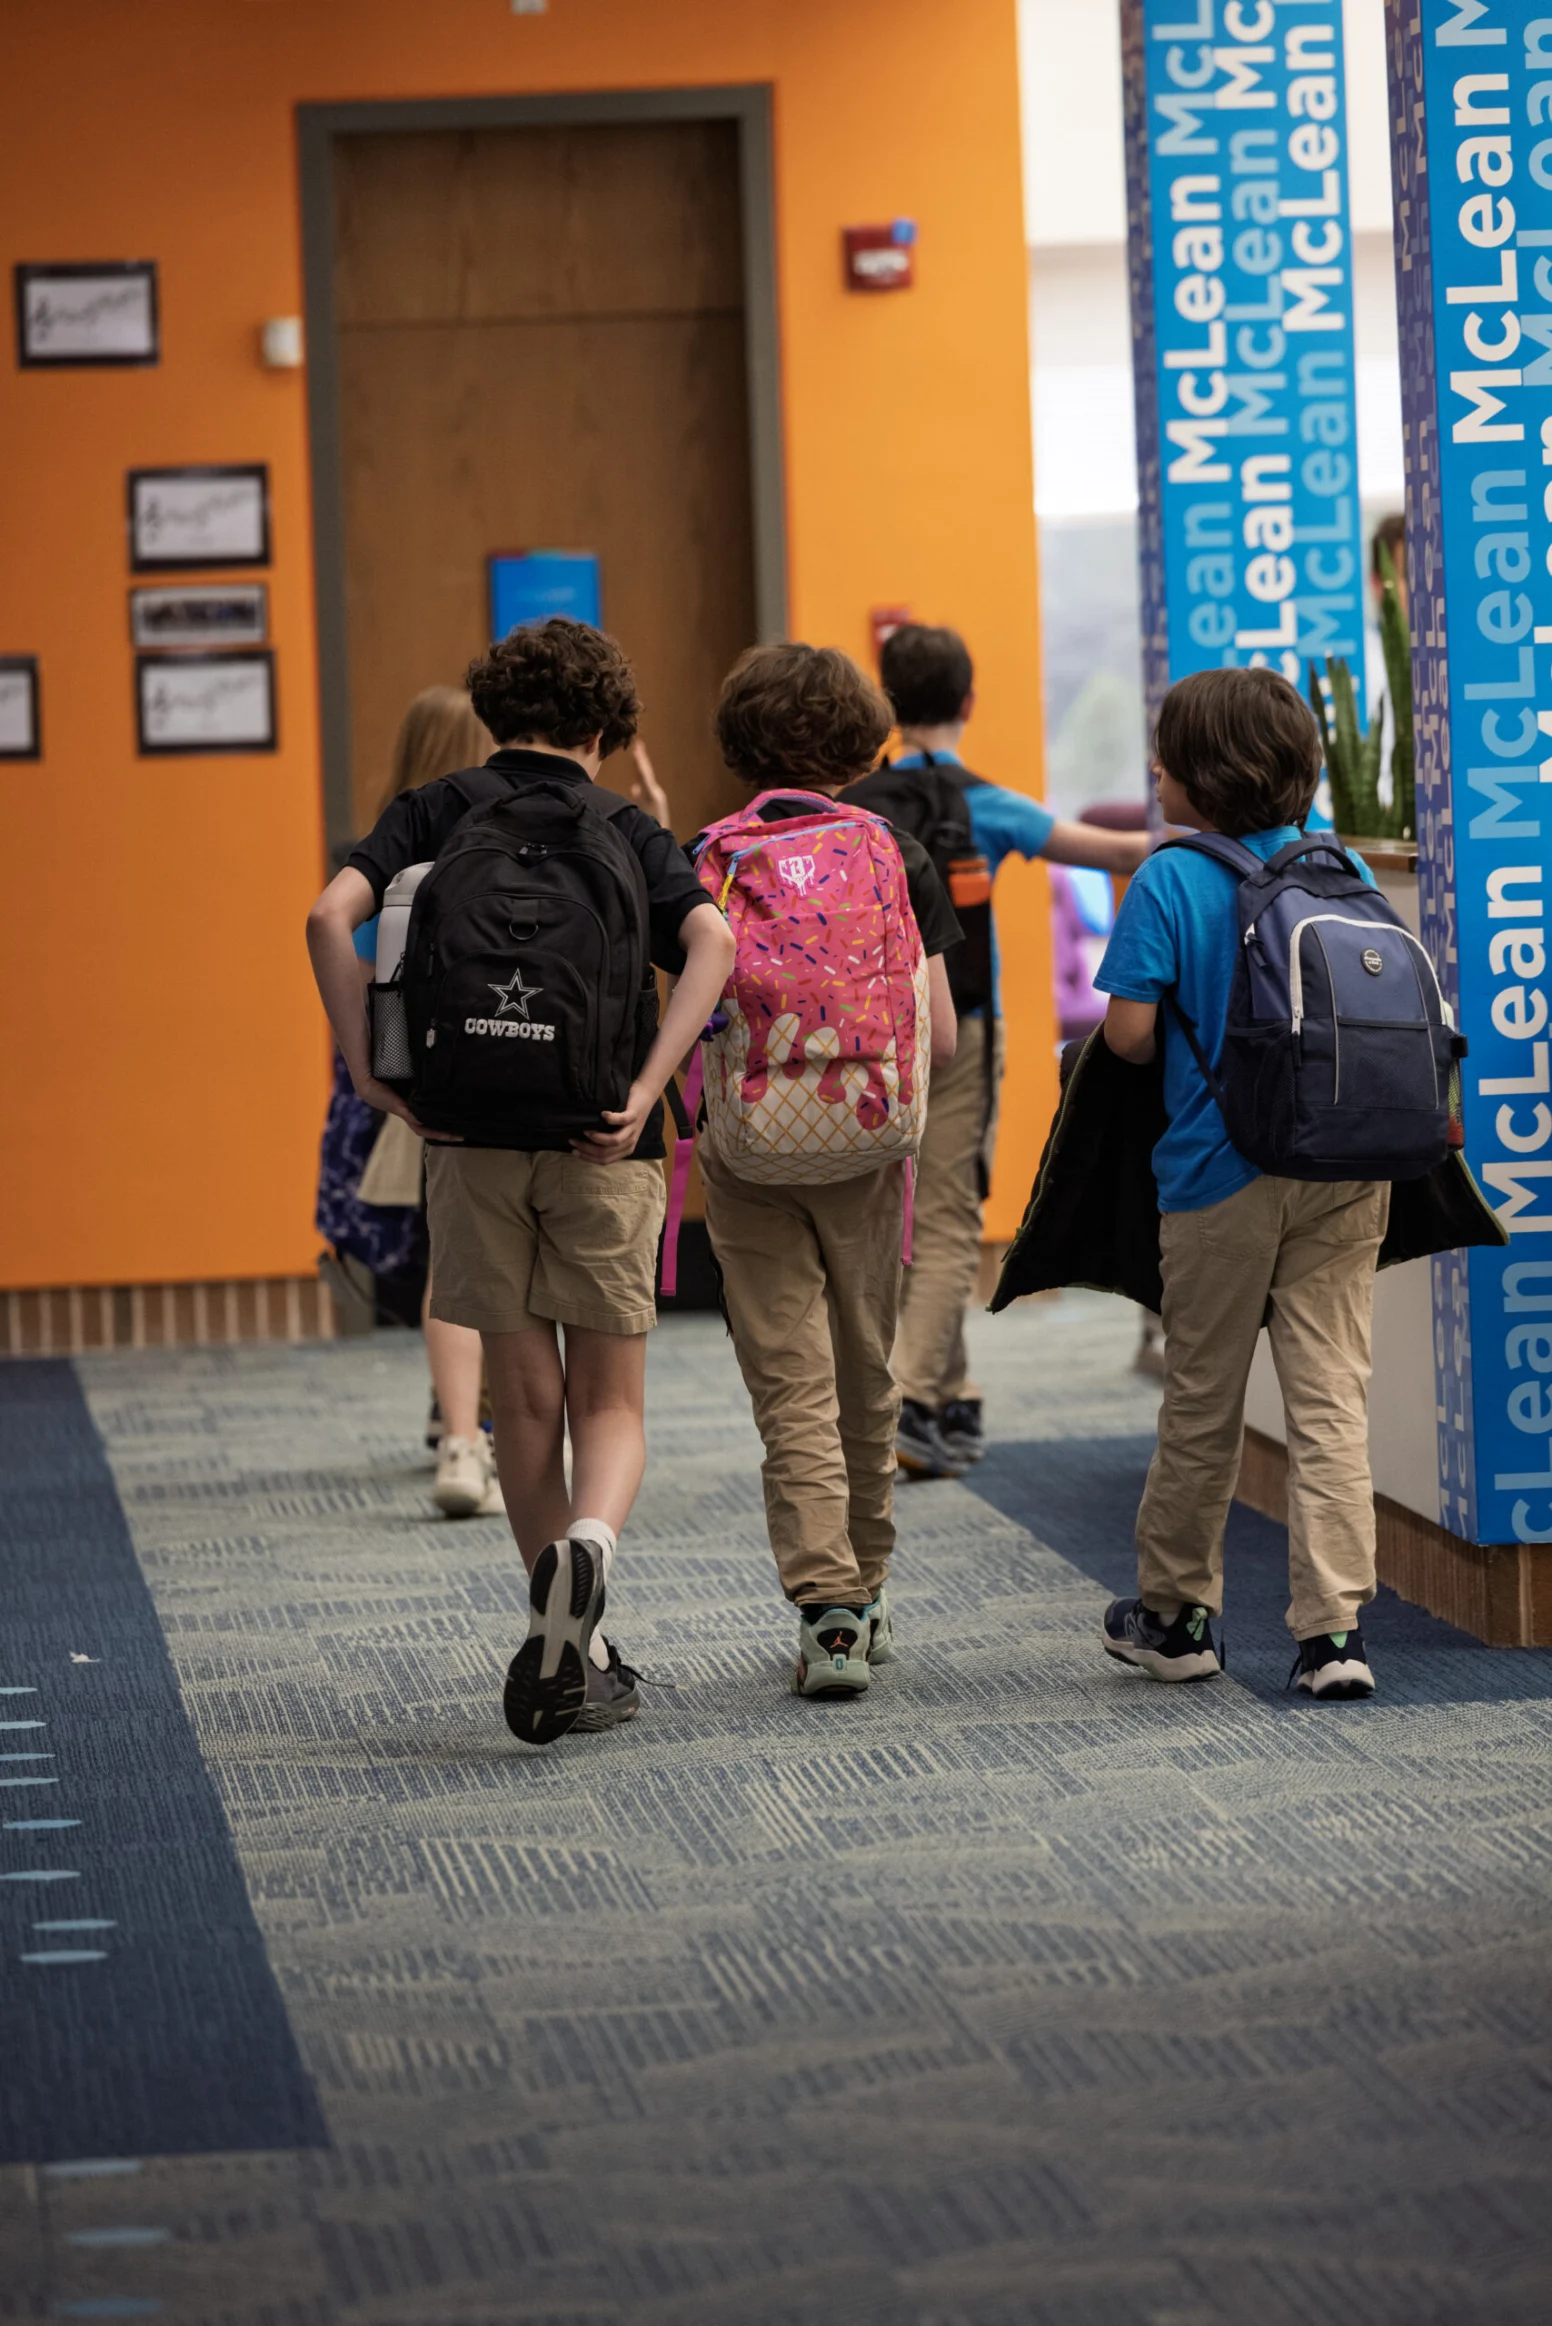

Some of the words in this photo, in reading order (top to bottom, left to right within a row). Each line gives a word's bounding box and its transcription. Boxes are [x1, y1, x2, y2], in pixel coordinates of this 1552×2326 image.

[1163, 175, 1232, 484] McLean
[1223, 129, 1290, 436] McLean
[1278, 24, 1345, 332] McLean
[1446, 73, 1525, 444] McLean
[1182, 503, 1237, 670] ean
[1293, 350, 1357, 659] McLean
[1464, 469, 1540, 839] McLean
[464, 1018, 555, 1041] COWBOYS
[1479, 866, 1552, 1233] McLean
